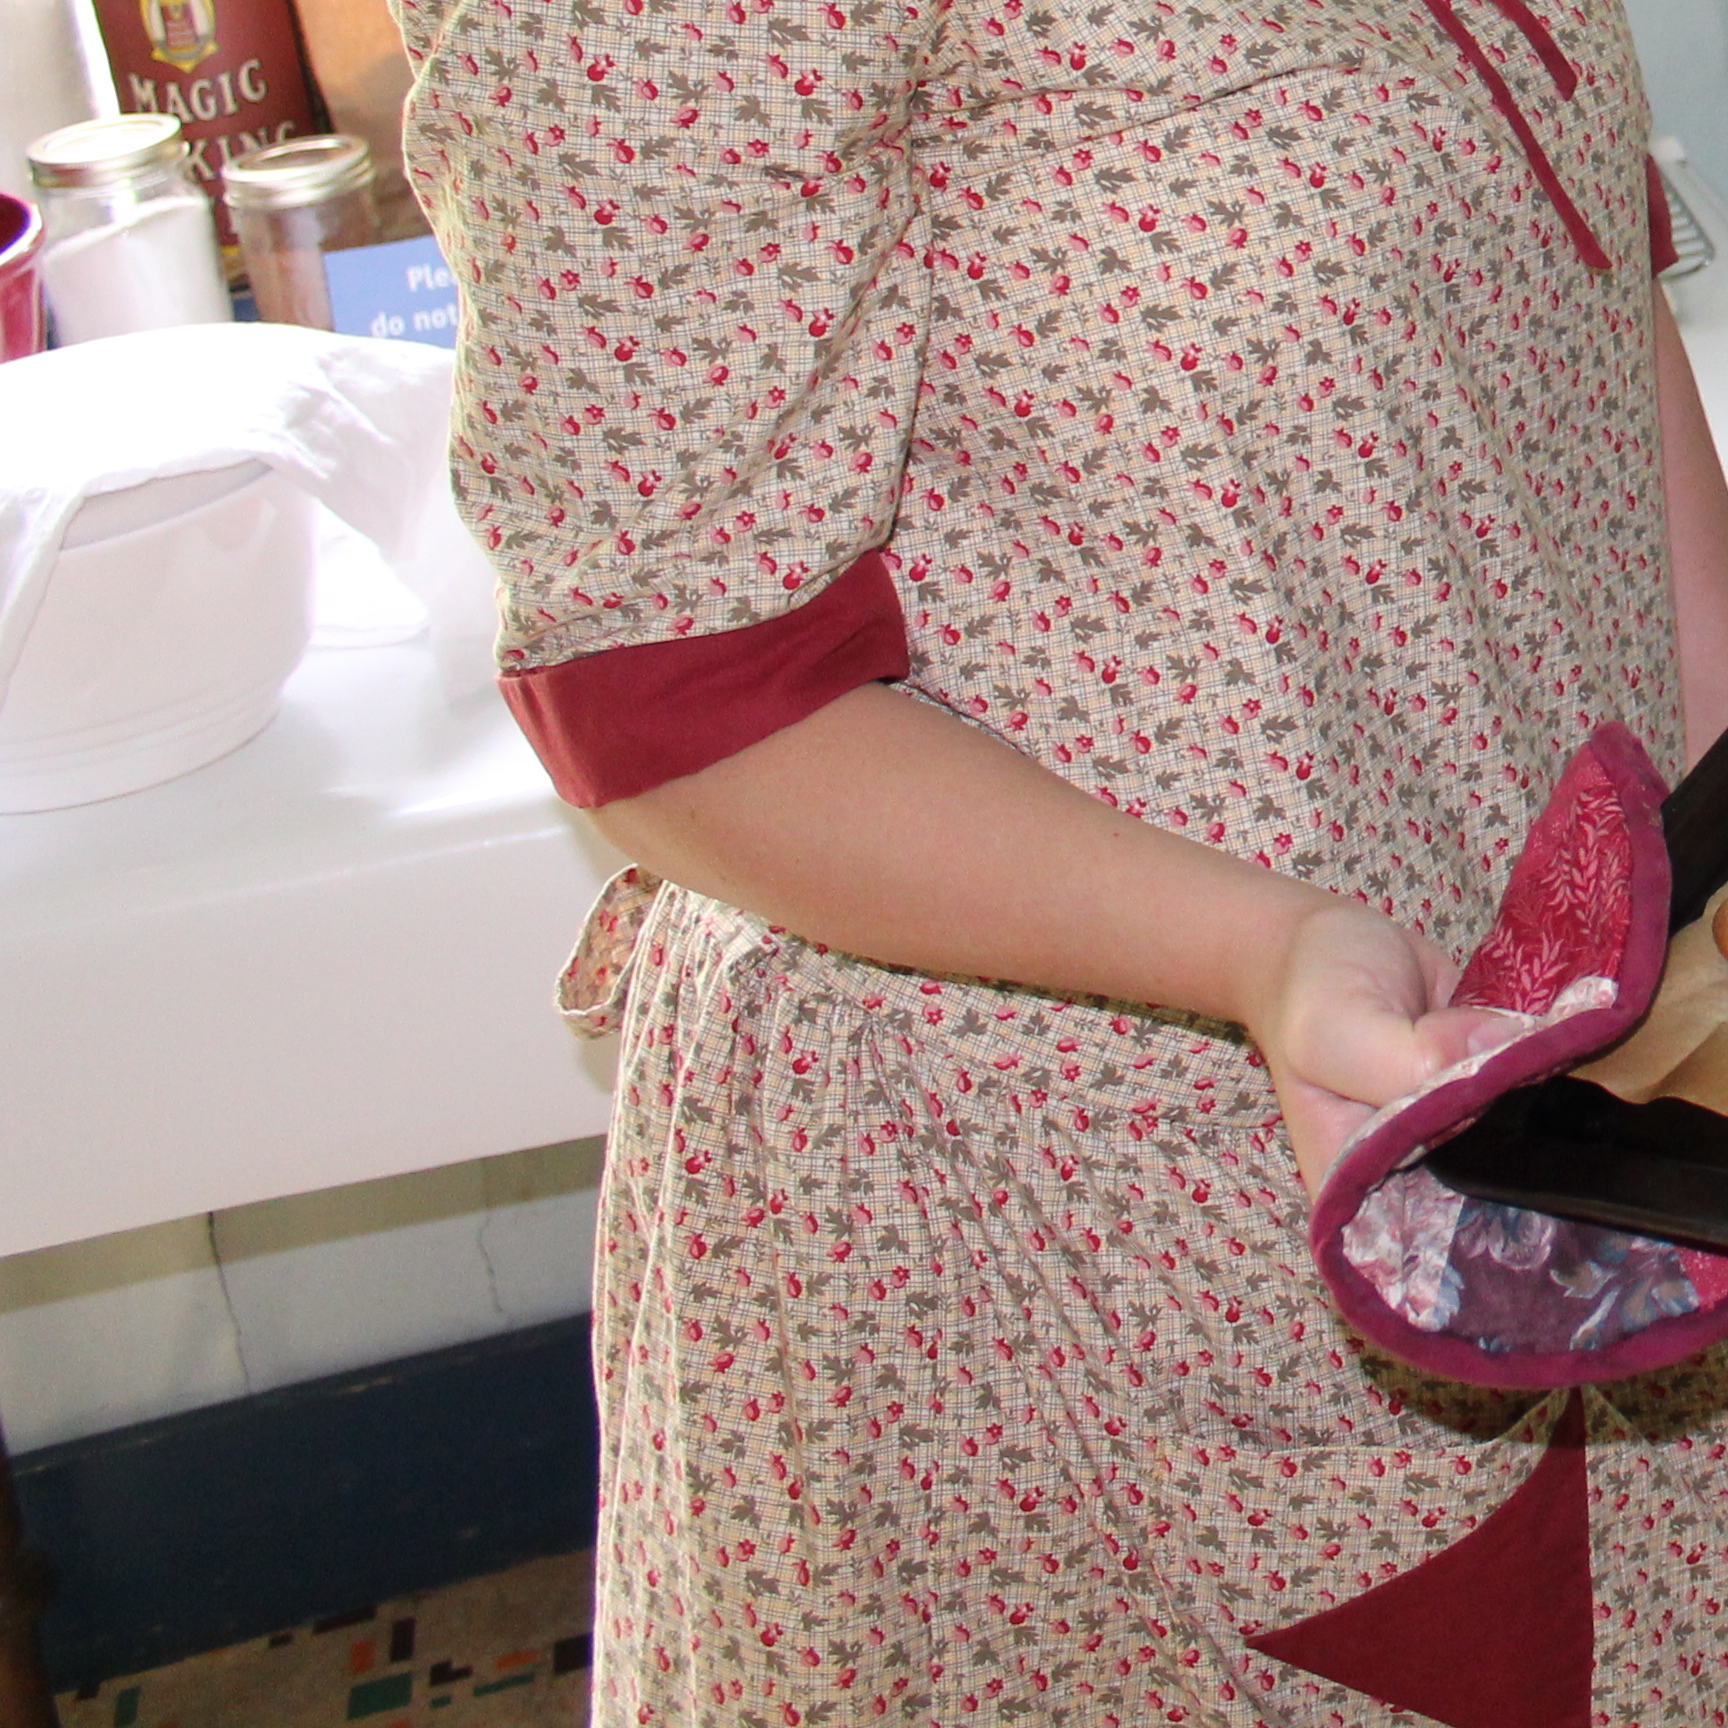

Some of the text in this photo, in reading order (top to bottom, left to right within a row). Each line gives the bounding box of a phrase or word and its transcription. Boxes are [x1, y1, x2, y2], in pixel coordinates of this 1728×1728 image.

[128, 58, 268, 123] MAGIC
[405, 262, 458, 292] Ple
[370, 303, 458, 337] do not
